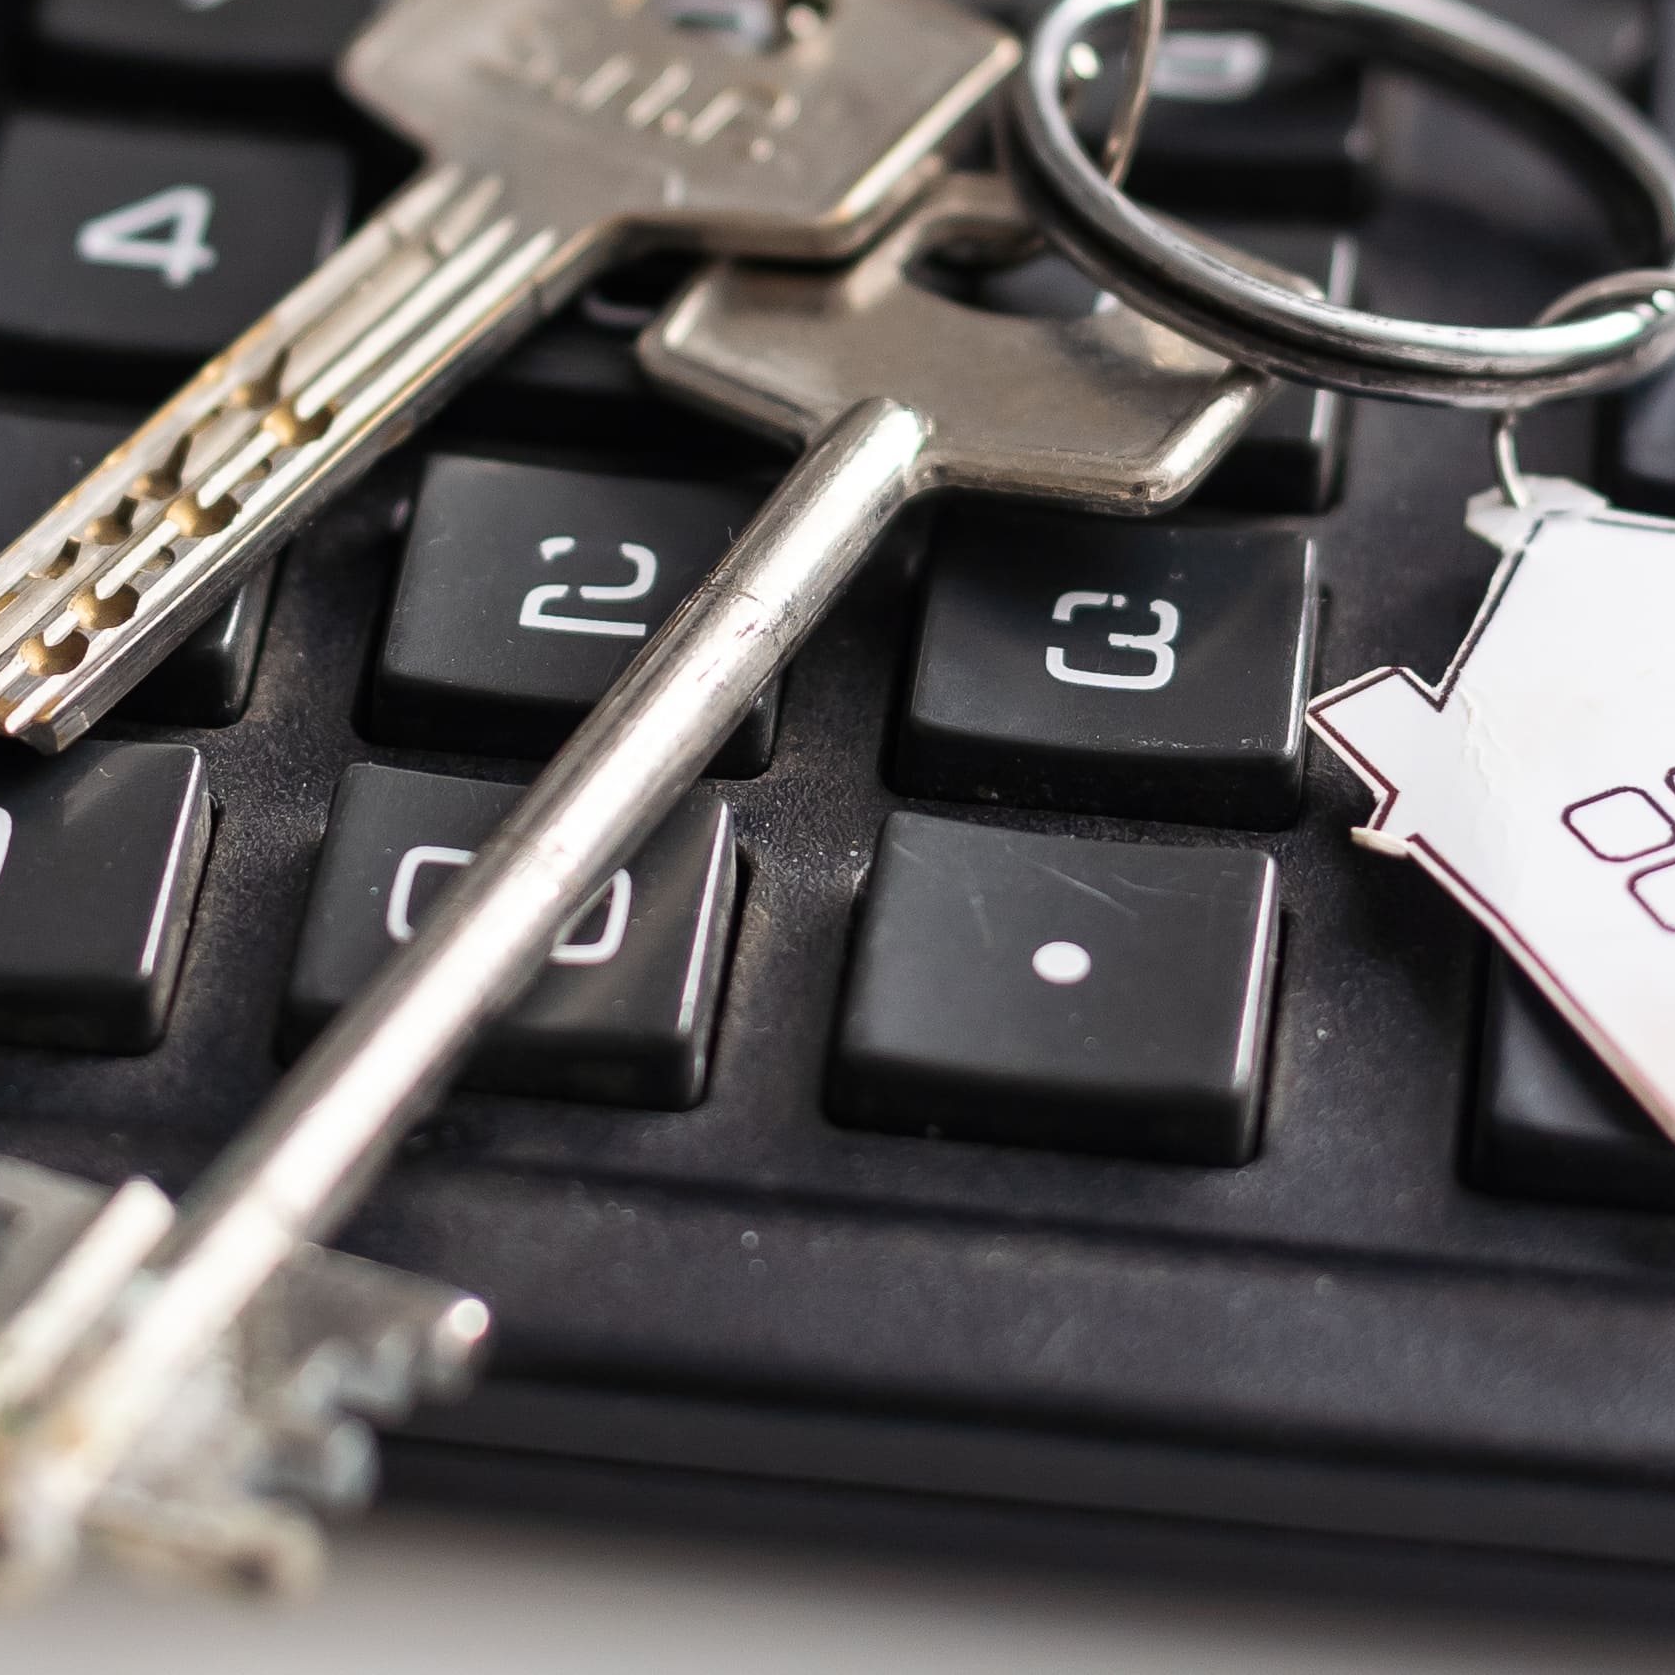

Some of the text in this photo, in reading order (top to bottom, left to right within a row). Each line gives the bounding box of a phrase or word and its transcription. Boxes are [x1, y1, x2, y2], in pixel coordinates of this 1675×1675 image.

[75, 185, 217, 287] 4
[517, 535, 660, 639] 2
[1043, 590, 1182, 692] 3
